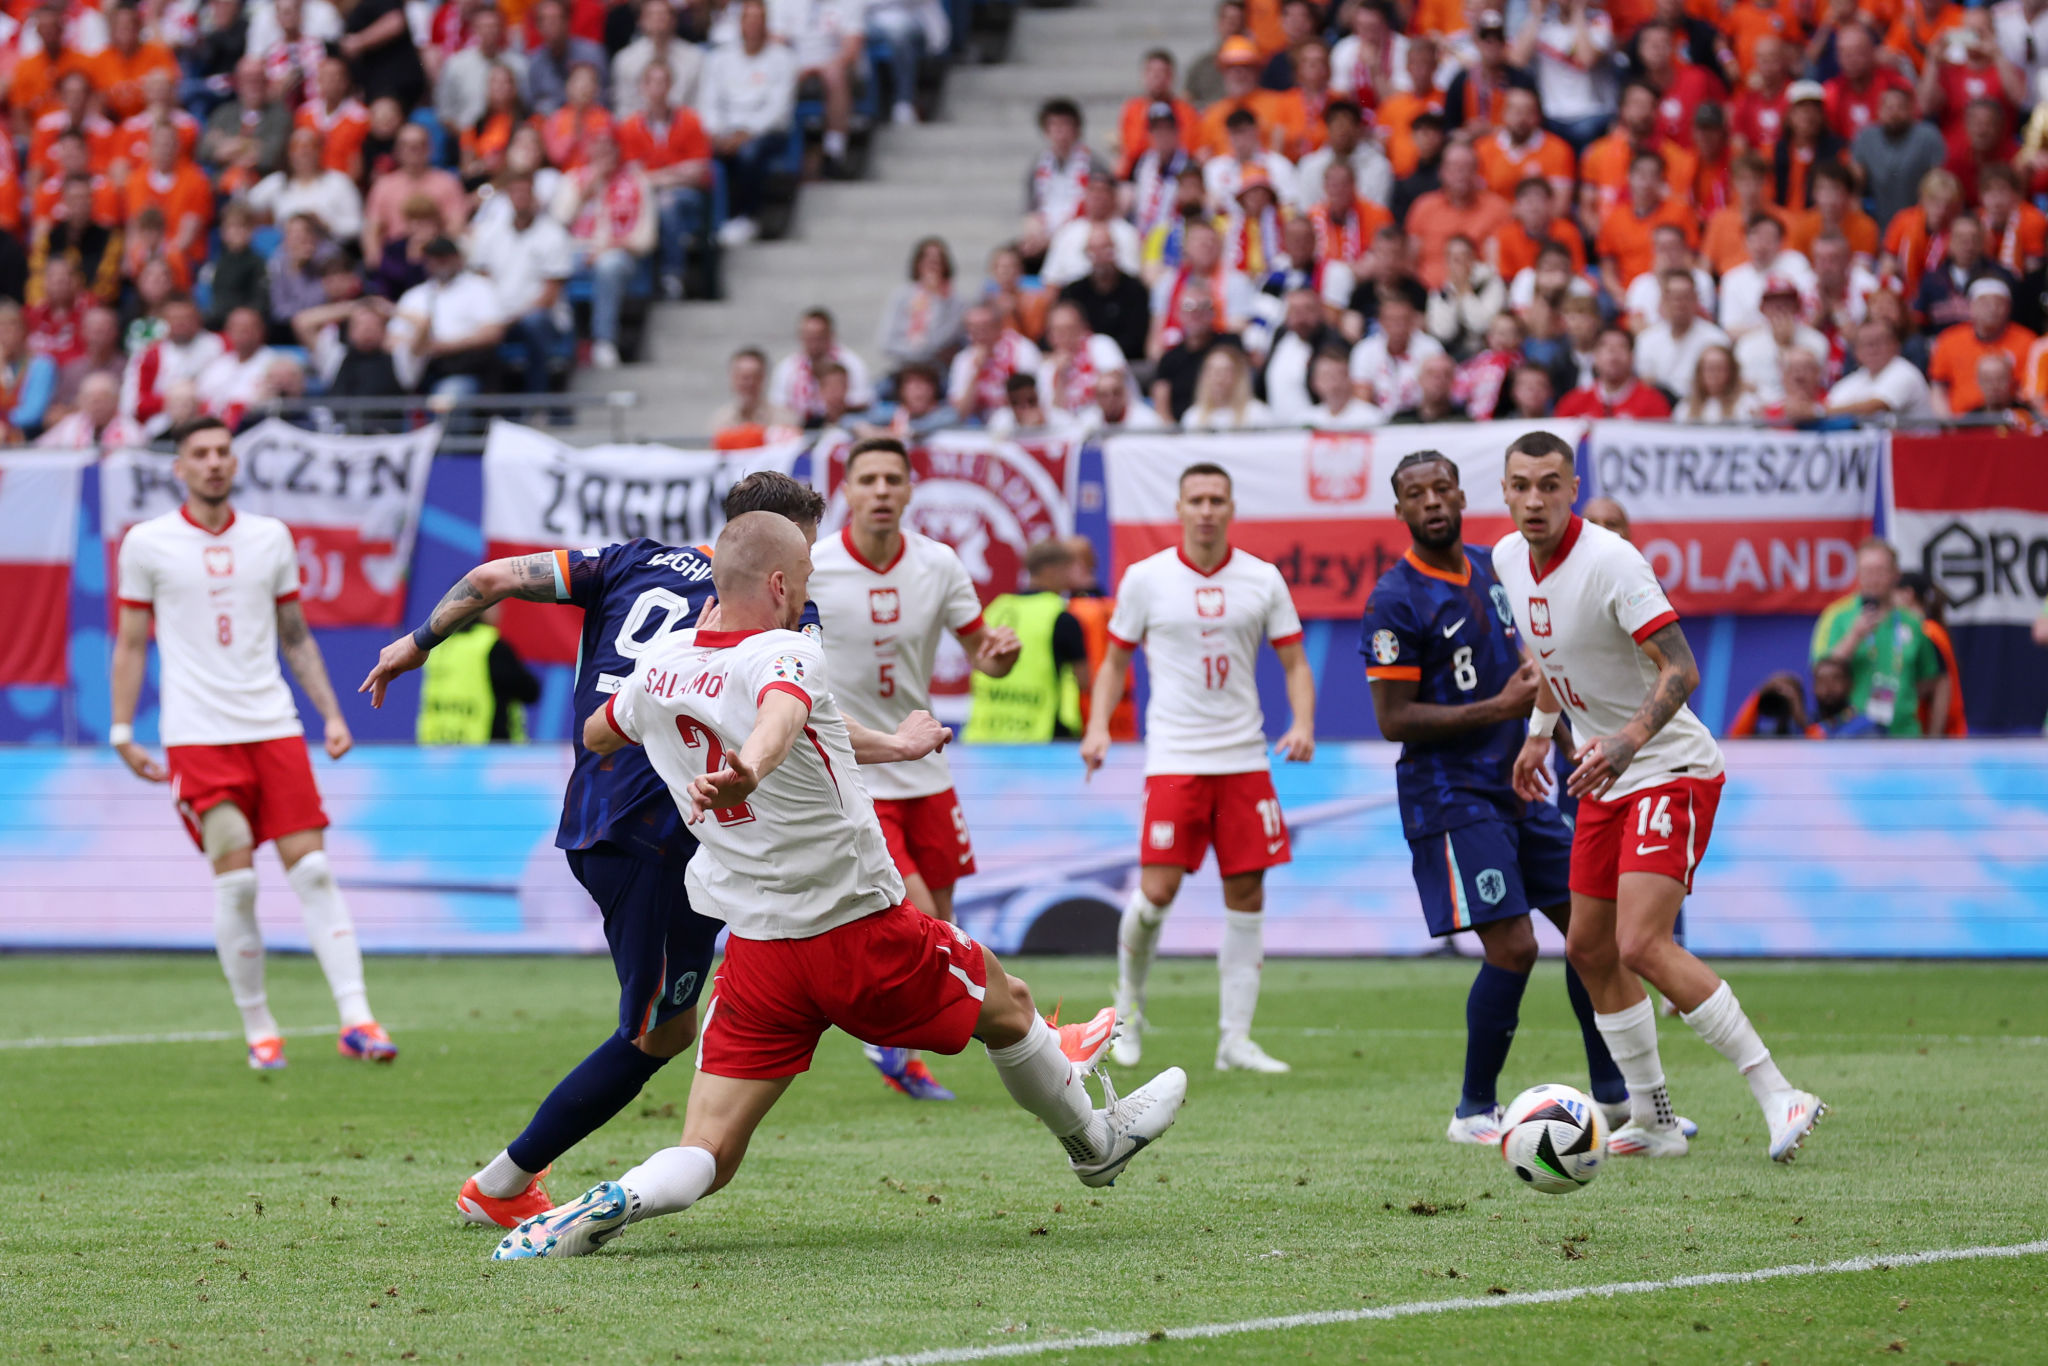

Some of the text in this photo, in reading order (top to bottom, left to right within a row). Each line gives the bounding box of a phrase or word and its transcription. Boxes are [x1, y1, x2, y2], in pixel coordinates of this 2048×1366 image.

[1600, 440, 1874, 495] OSTRZESZÓW
[1640, 537, 1858, 593] OLAND
[215, 613, 233, 648] 8
[878, 663, 896, 699] 5
[1201, 654, 1230, 691] 19
[1453, 645, 1479, 692] 8
[1550, 676, 1590, 712] 14
[675, 713, 758, 828] 2
[1636, 795, 1673, 839] 14
